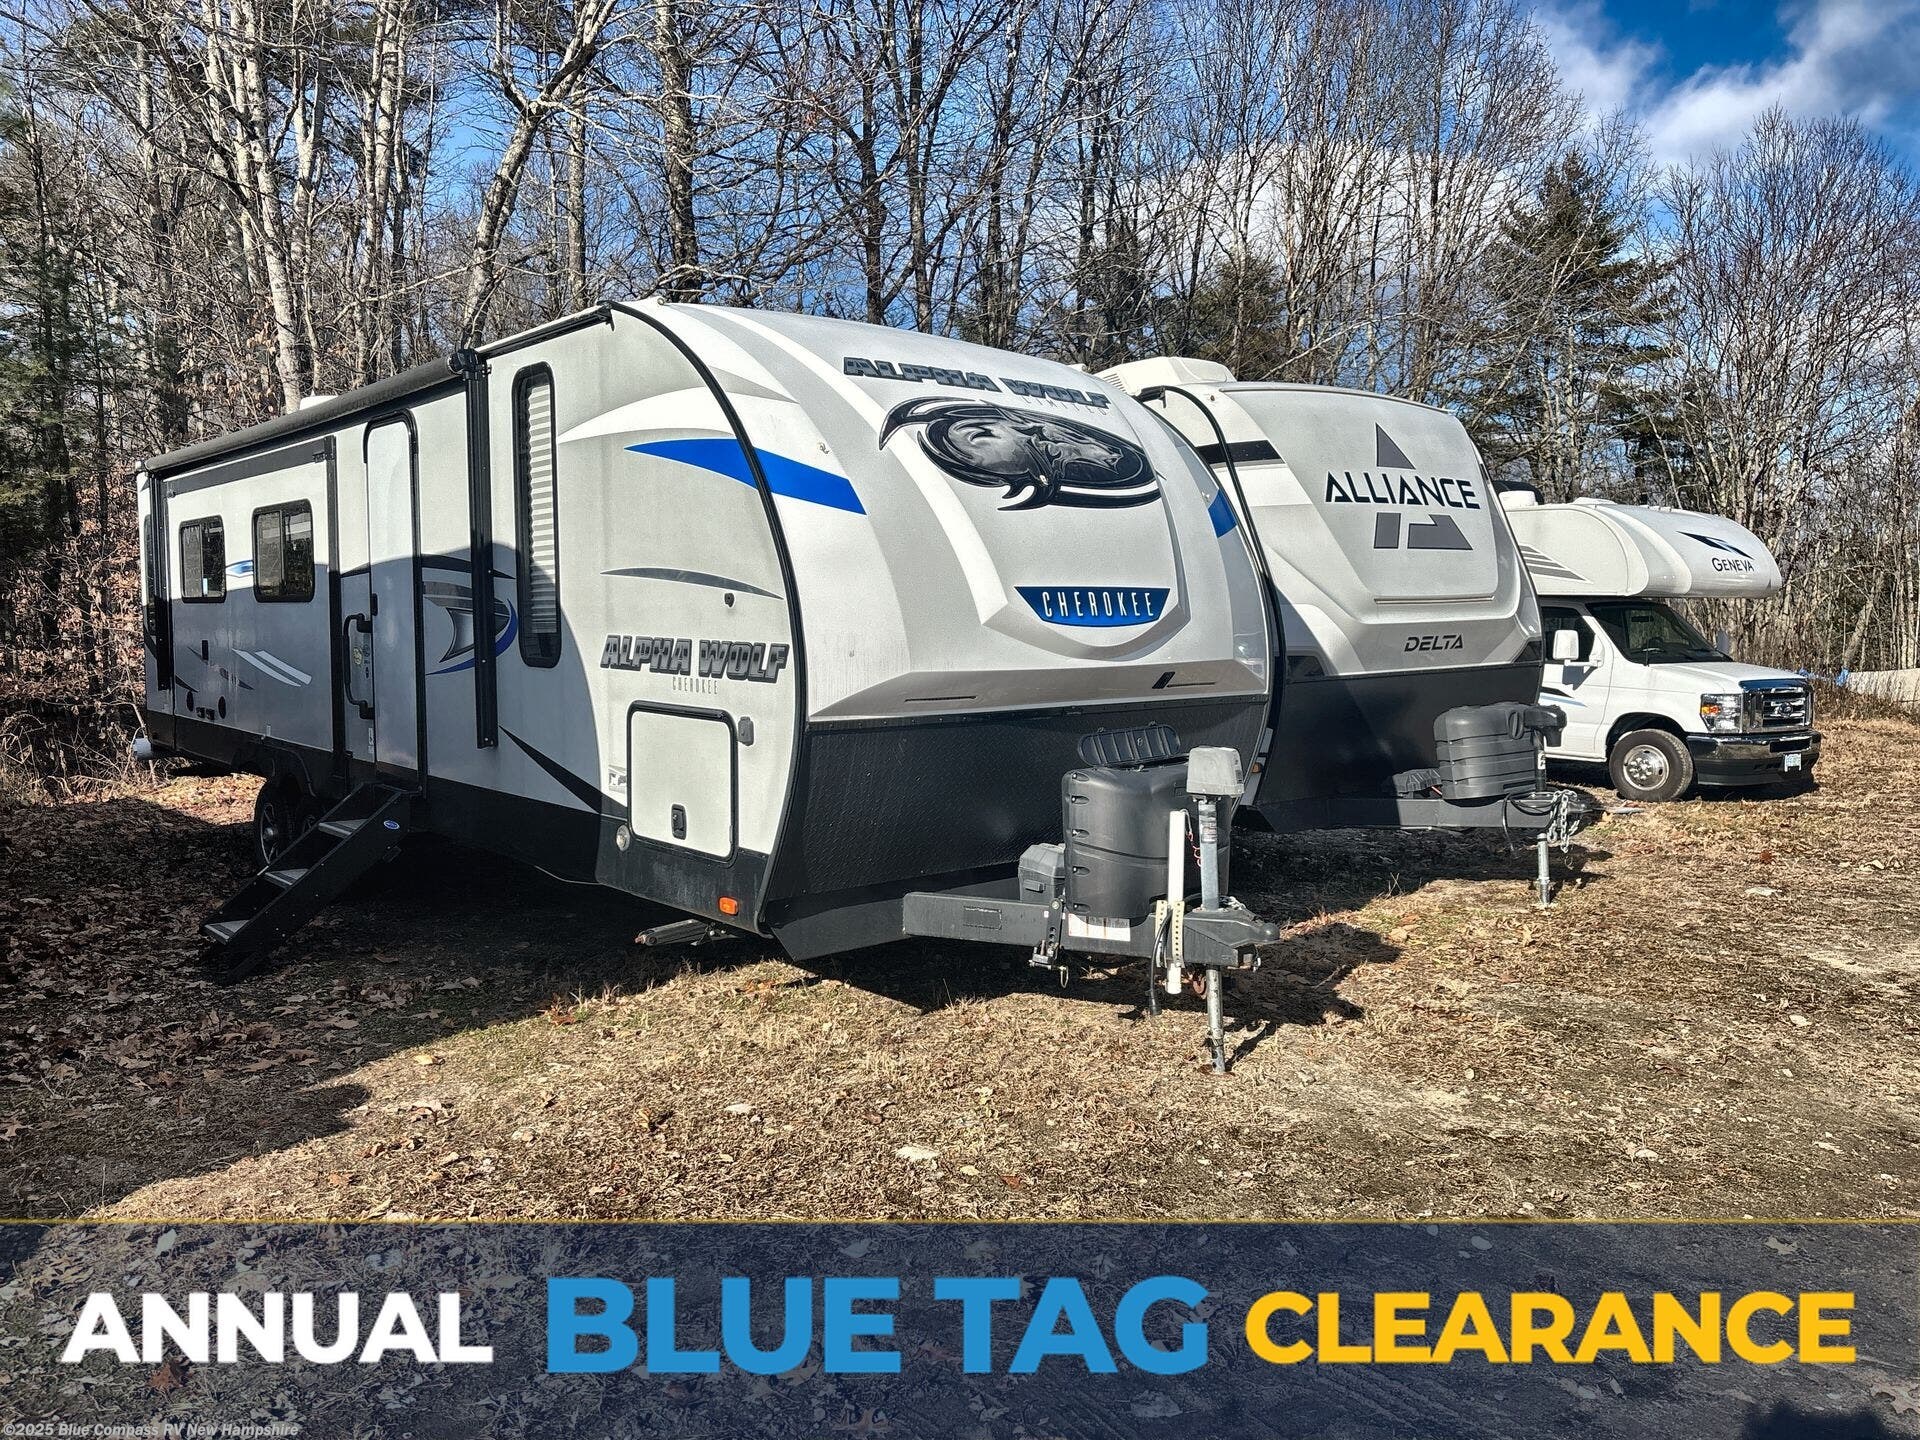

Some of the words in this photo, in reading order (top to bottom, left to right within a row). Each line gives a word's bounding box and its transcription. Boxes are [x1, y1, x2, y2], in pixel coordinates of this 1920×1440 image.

[844, 356, 1002, 393] ALPHA
[1000, 377, 1112, 409] WOLF
[1325, 471, 1480, 510] ALLIANCE
[1711, 556, 1755, 573] GENEVA
[1042, 591, 1155, 617] CHEROKEE
[600, 634, 692, 677] ALPHA
[698, 640, 790, 684] WOLF
[1404, 634, 1463, 652] DELTA
